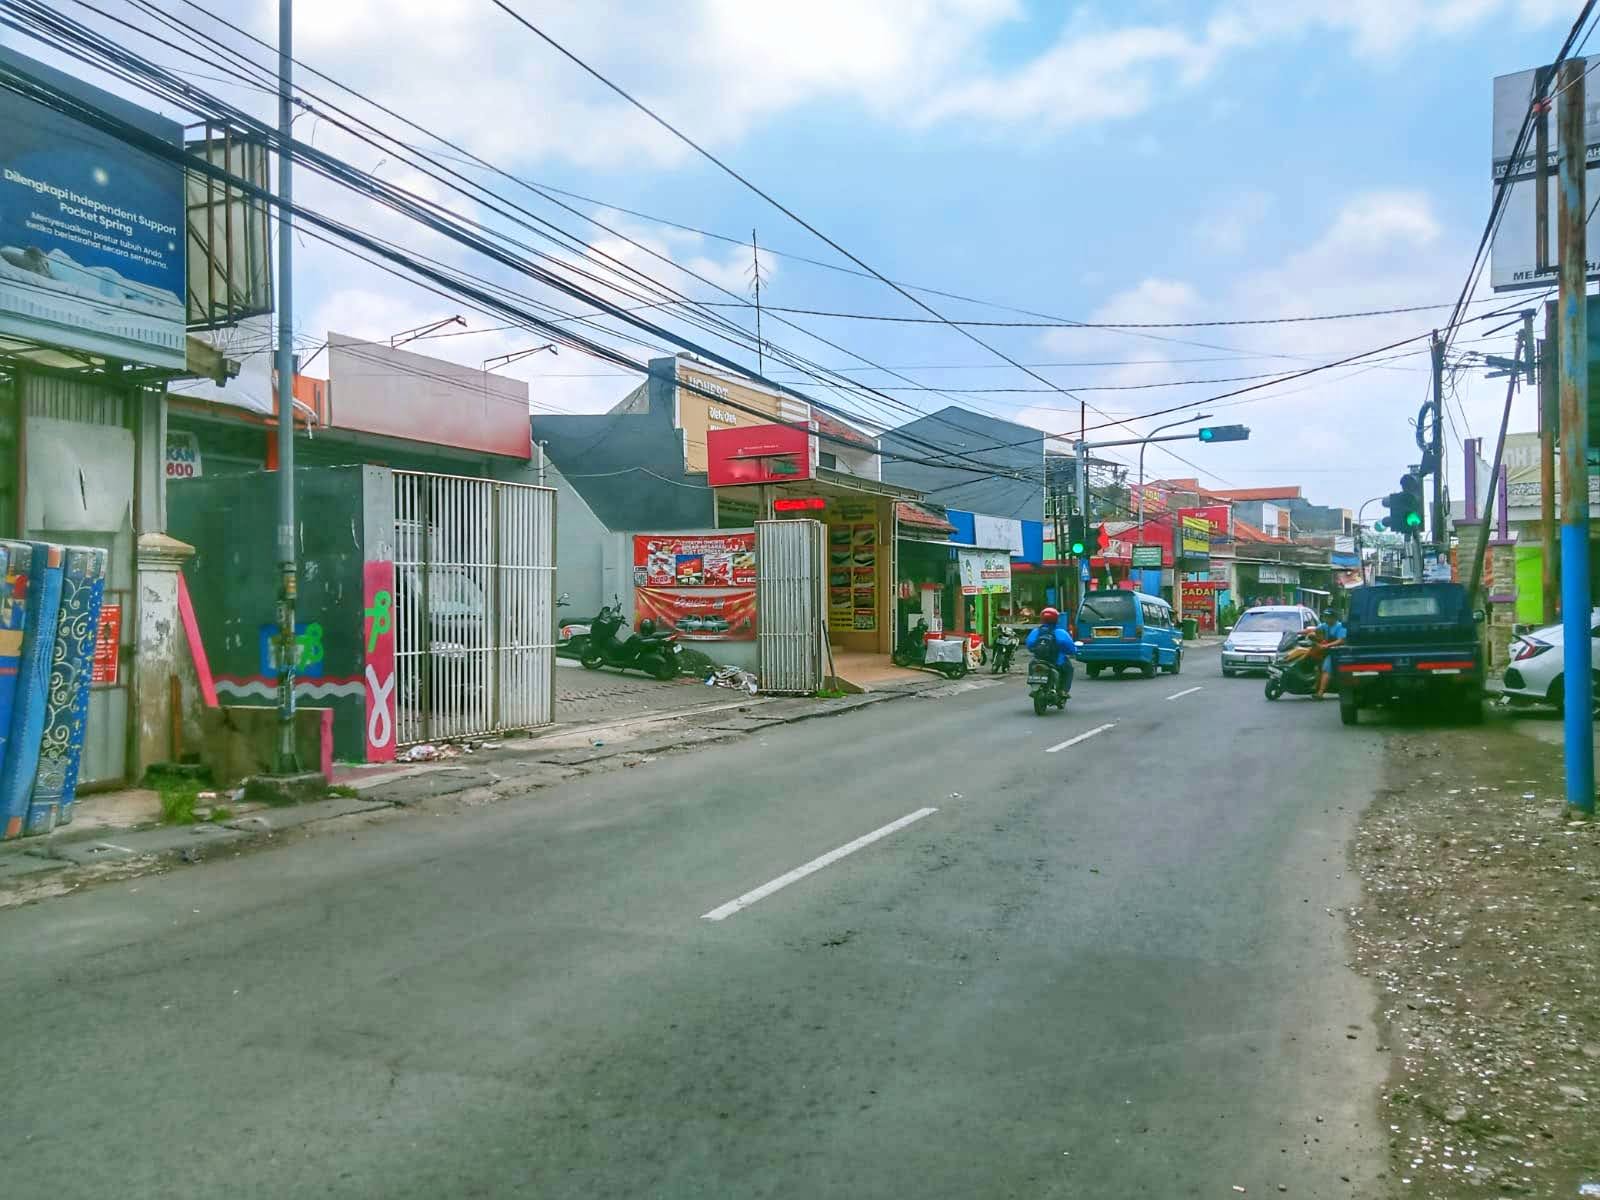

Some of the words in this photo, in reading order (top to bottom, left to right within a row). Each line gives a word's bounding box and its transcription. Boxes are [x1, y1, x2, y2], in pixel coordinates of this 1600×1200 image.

[4, 168, 69, 200] Dilengkapi
[70, 191, 138, 223] Independent
[138, 215, 177, 236] Support
[59, 202, 98, 223] Pocket
[99, 215, 133, 236] Spring
[93, 230, 119, 244] postur
[119, 239, 142, 252] tubuh
